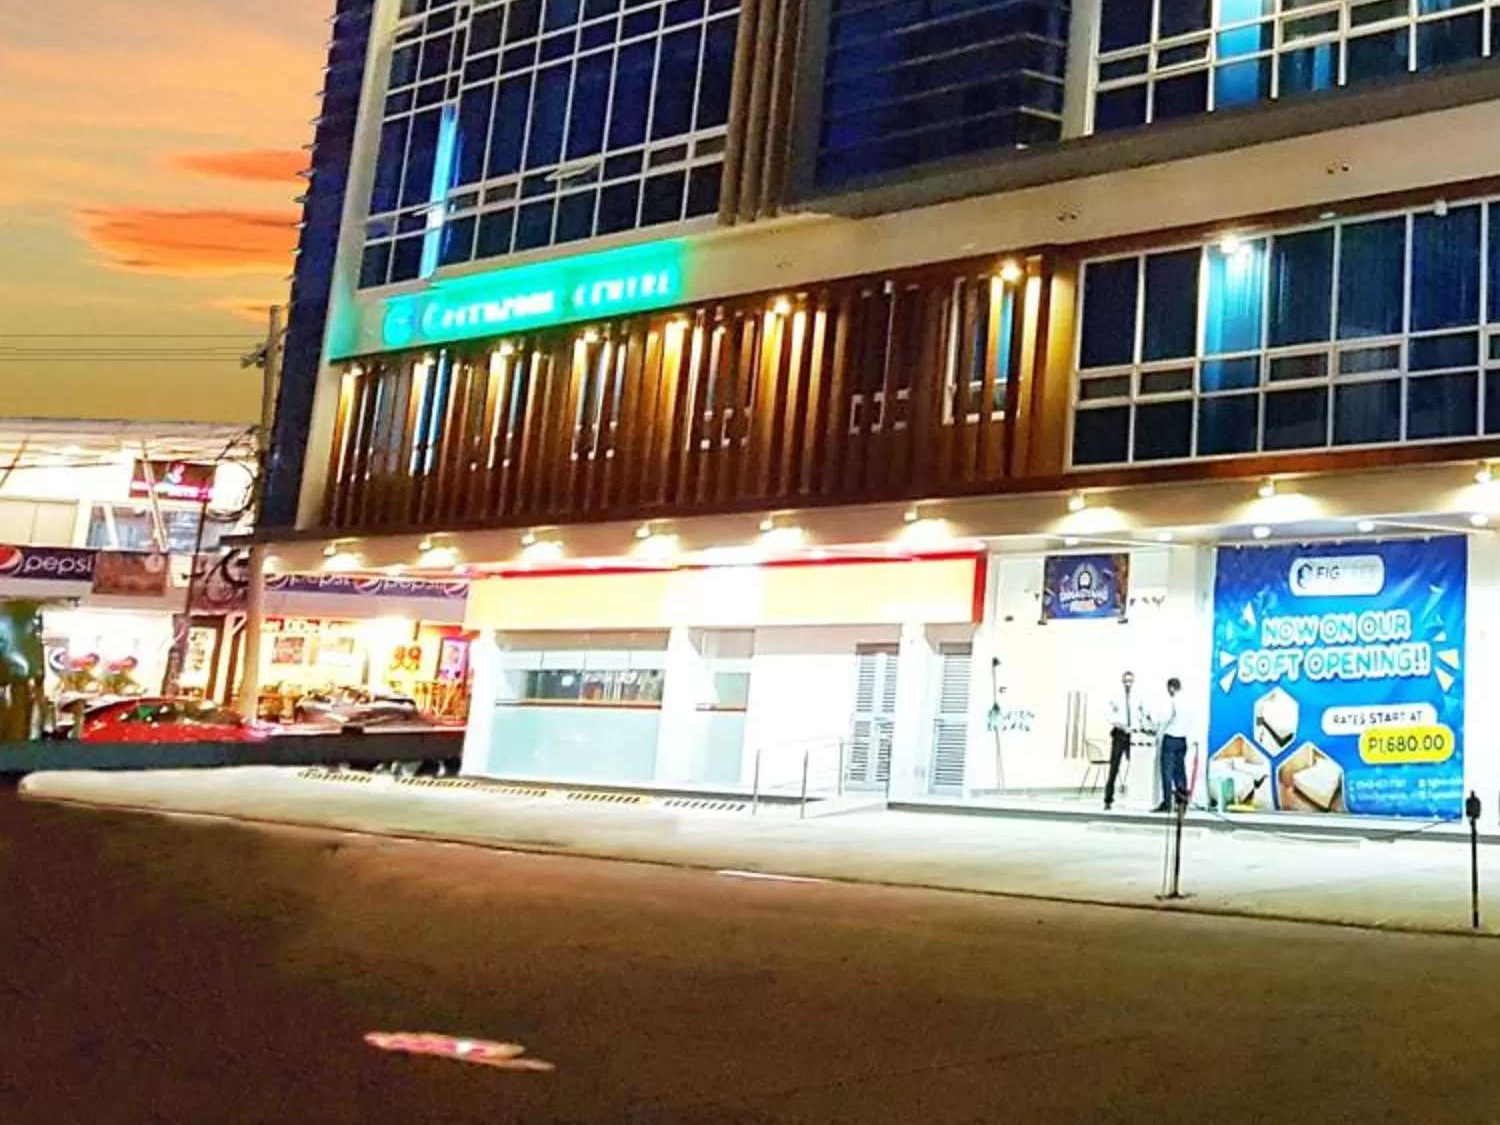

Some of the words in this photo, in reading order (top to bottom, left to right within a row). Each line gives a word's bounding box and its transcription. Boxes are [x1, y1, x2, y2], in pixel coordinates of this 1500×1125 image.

[23, 554, 92, 575] pepsi
[1261, 615, 1318, 646] NOW
[1320, 613, 1357, 643] ON
[1359, 609, 1412, 641] OUR
[1239, 648, 1303, 682] SOFT
[1305, 642, 1431, 679] OPENING!!
